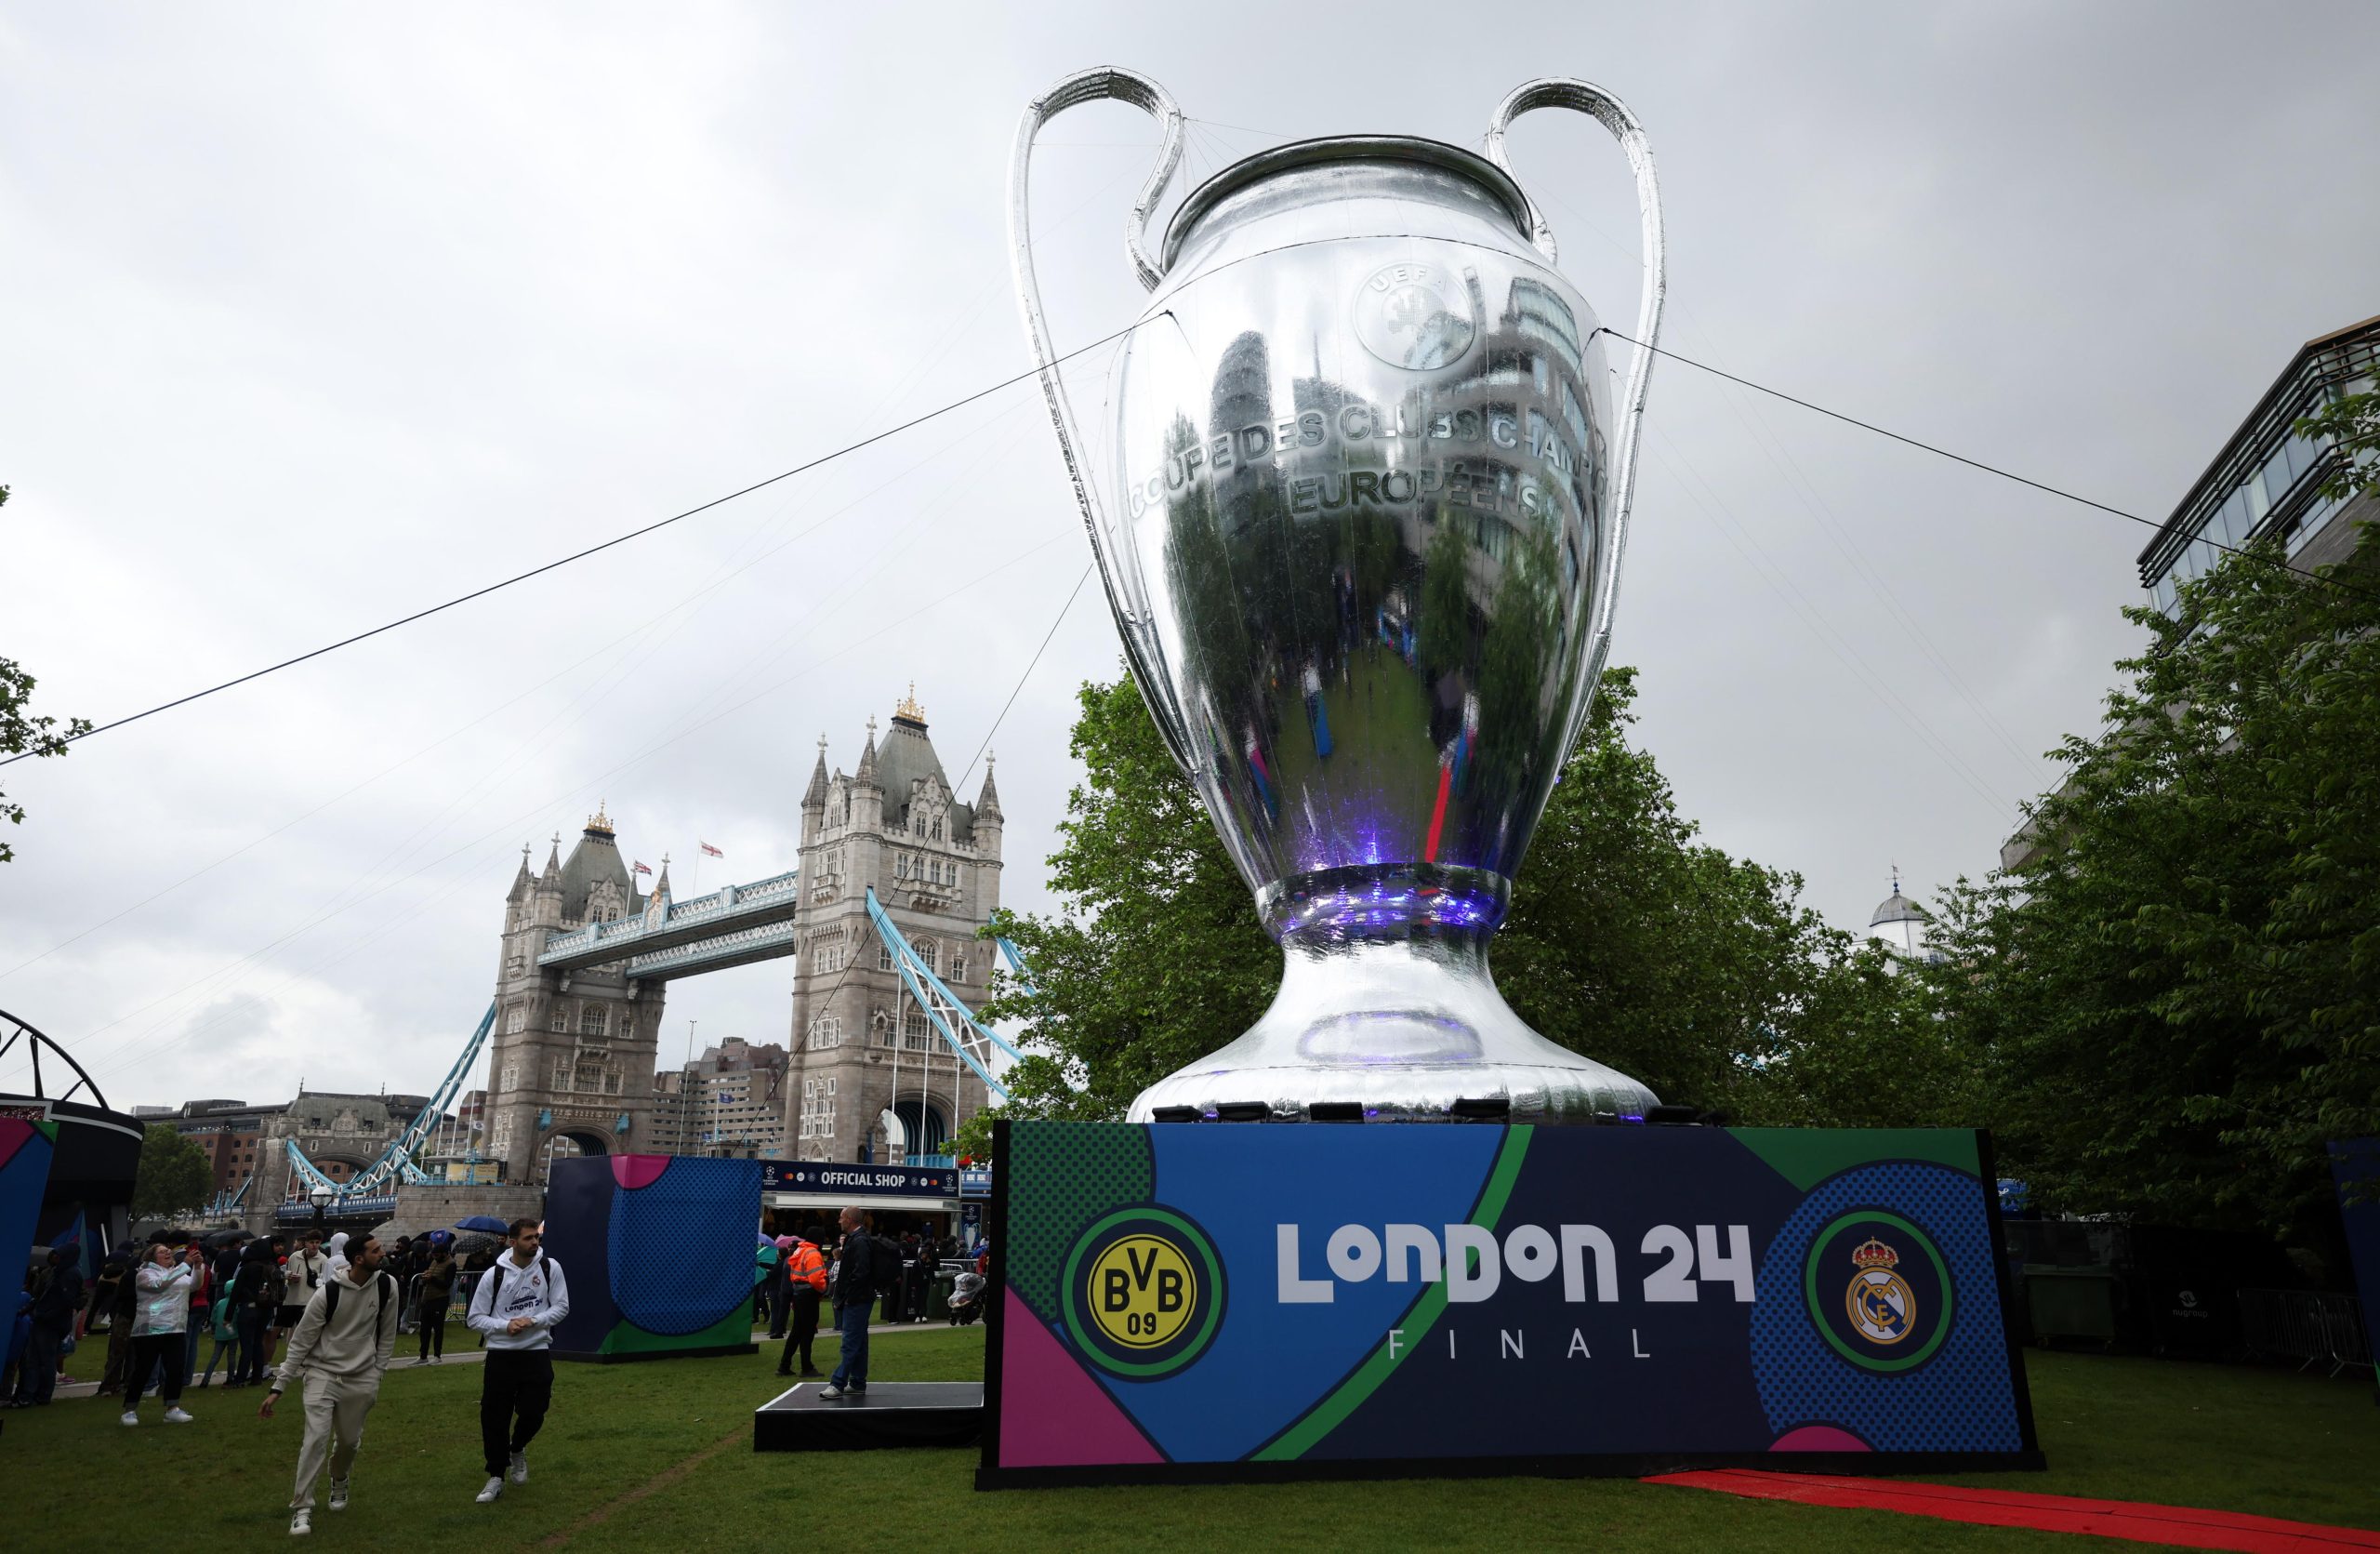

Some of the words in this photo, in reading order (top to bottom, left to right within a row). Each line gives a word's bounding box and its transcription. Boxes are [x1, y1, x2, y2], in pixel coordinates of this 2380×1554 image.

[1130, 433, 1234, 519] COUPE
[1241, 411, 1328, 461] DES
[1340, 405, 1480, 443] CLUBS
[1290, 463, 1540, 517] EUROPÉENS
[821, 1172, 873, 1186] OFFICIAL
[875, 1175, 906, 1188] SHOP
[1104, 1247, 1183, 1313] BVB
[1641, 1224, 1756, 1302] 24
[1127, 1311, 1157, 1336] 09
[1389, 1328, 1651, 1360] FINAL
